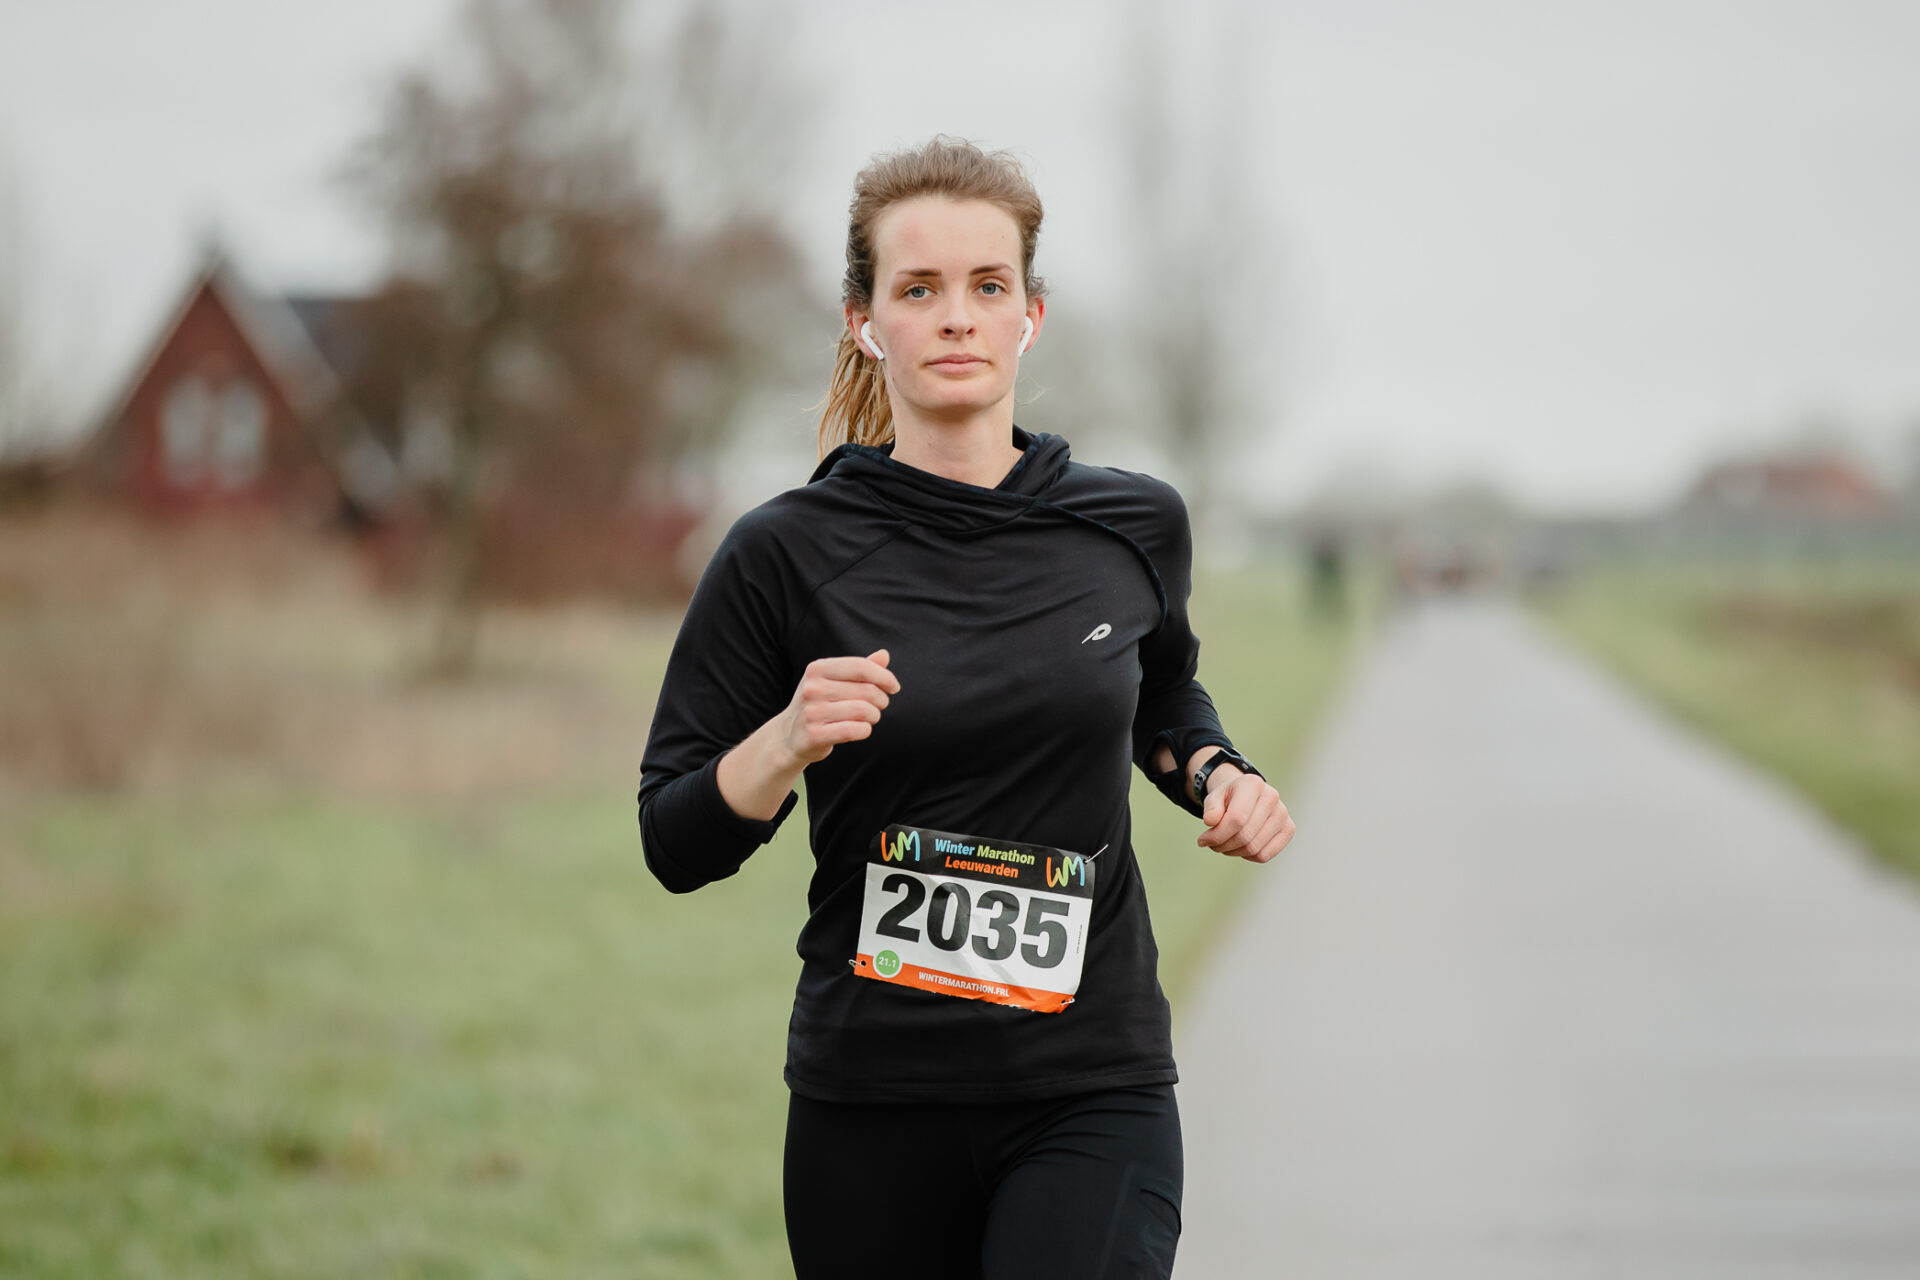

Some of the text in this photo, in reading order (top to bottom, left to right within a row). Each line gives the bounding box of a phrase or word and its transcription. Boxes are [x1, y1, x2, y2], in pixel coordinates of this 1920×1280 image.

[935, 838, 1036, 866] Winter Marathon
[944, 855, 1019, 879] Leeuwarden
[875, 873, 1071, 969] 2035
[878, 956, 897, 968] 21.1
[918, 972, 1010, 997] WINTERMARATHON.FRL
